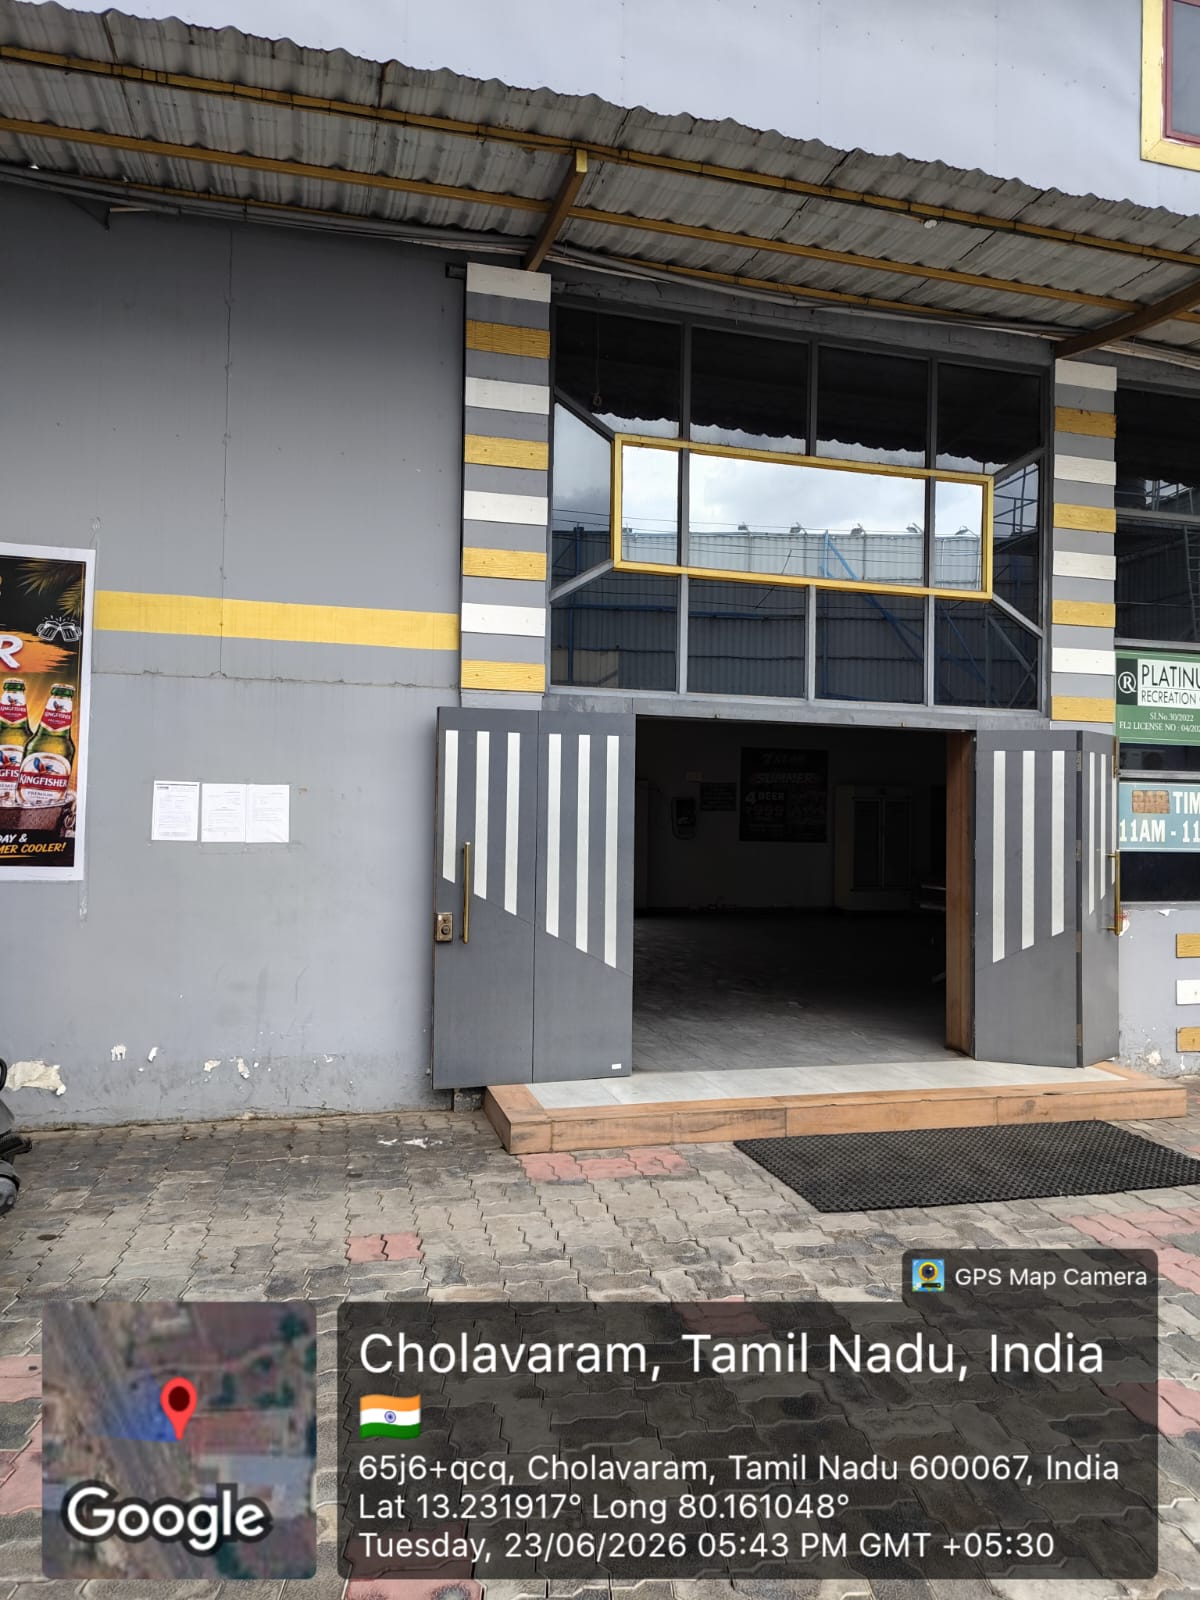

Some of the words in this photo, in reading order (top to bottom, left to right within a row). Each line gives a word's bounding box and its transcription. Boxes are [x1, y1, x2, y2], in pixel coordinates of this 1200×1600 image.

[1141, 690, 1197, 705] RECREATION
[1133, 722, 1163, 731] LICENSE
[1164, 723, 1177, 732] NO
[1120, 818, 1166, 843] 11AM
[20, 842, 67, 854] COOLER!
